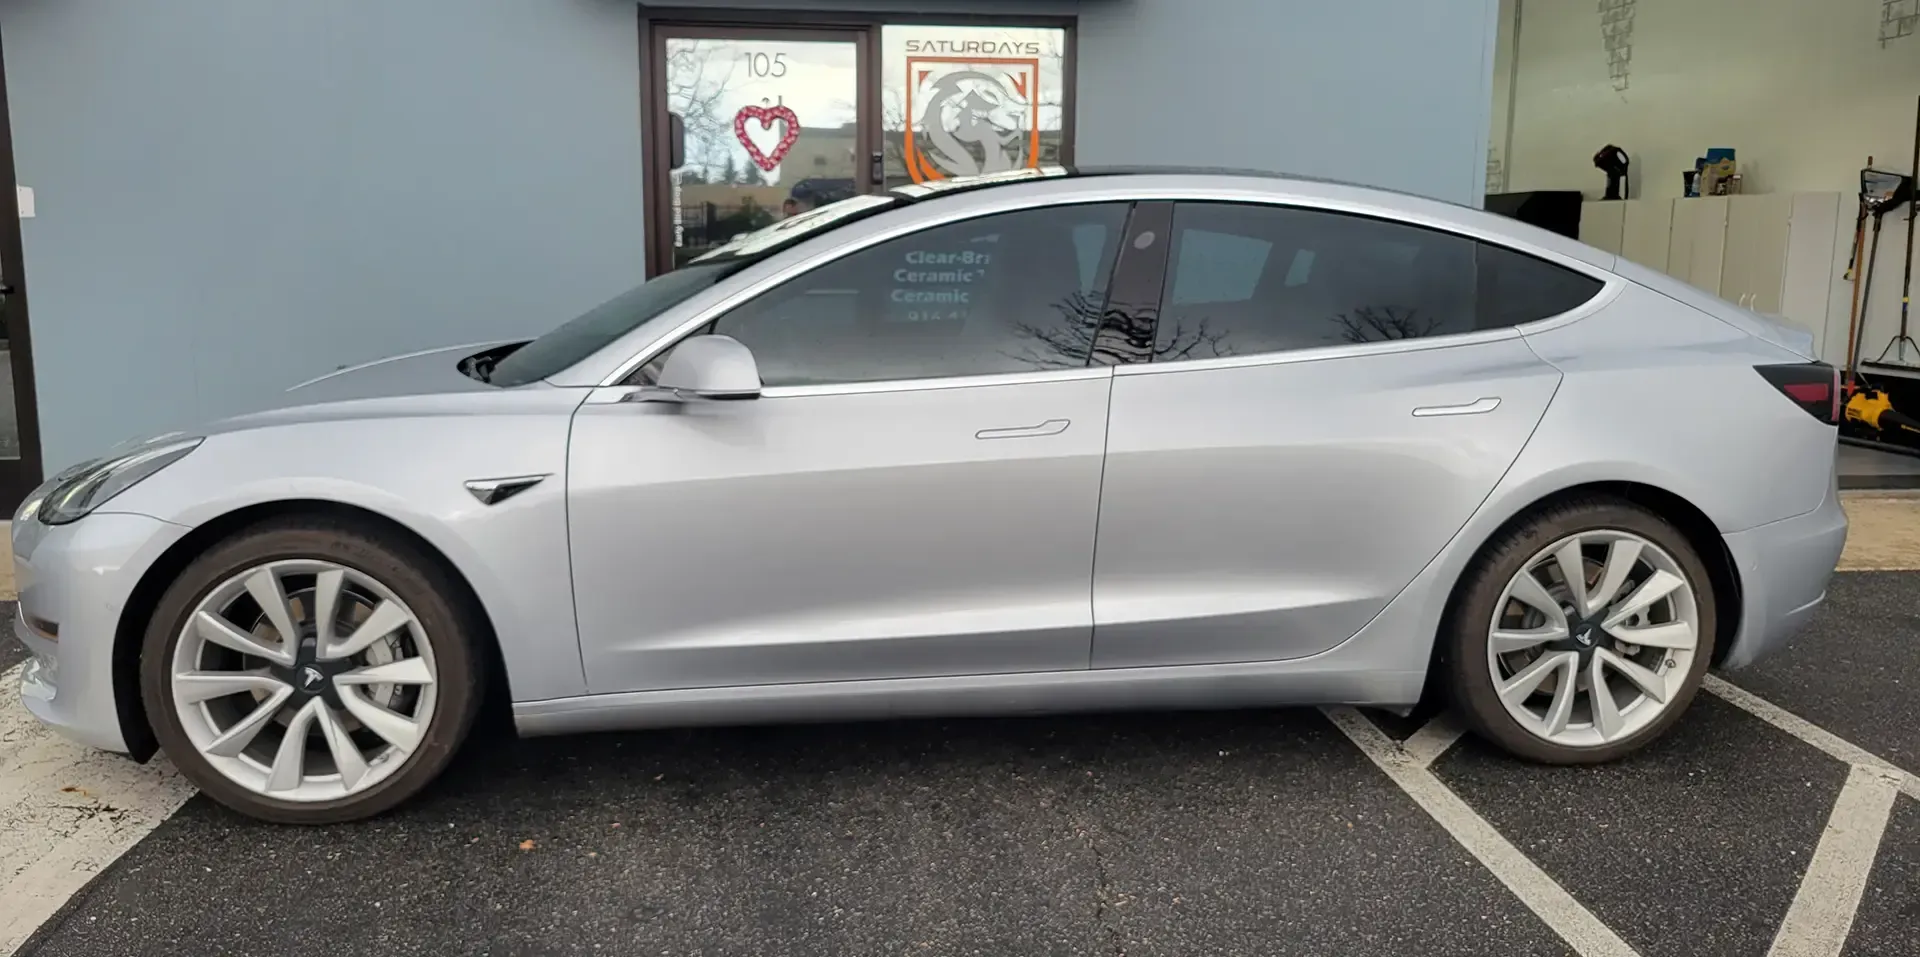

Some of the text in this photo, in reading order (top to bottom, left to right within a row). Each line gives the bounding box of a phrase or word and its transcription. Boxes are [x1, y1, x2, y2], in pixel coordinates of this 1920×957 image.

[906, 39, 1040, 54] SATURDAYS
[744, 52, 787, 77] 105
[893, 268, 974, 283] Ceramic
[890, 288, 970, 304] Ceramic
